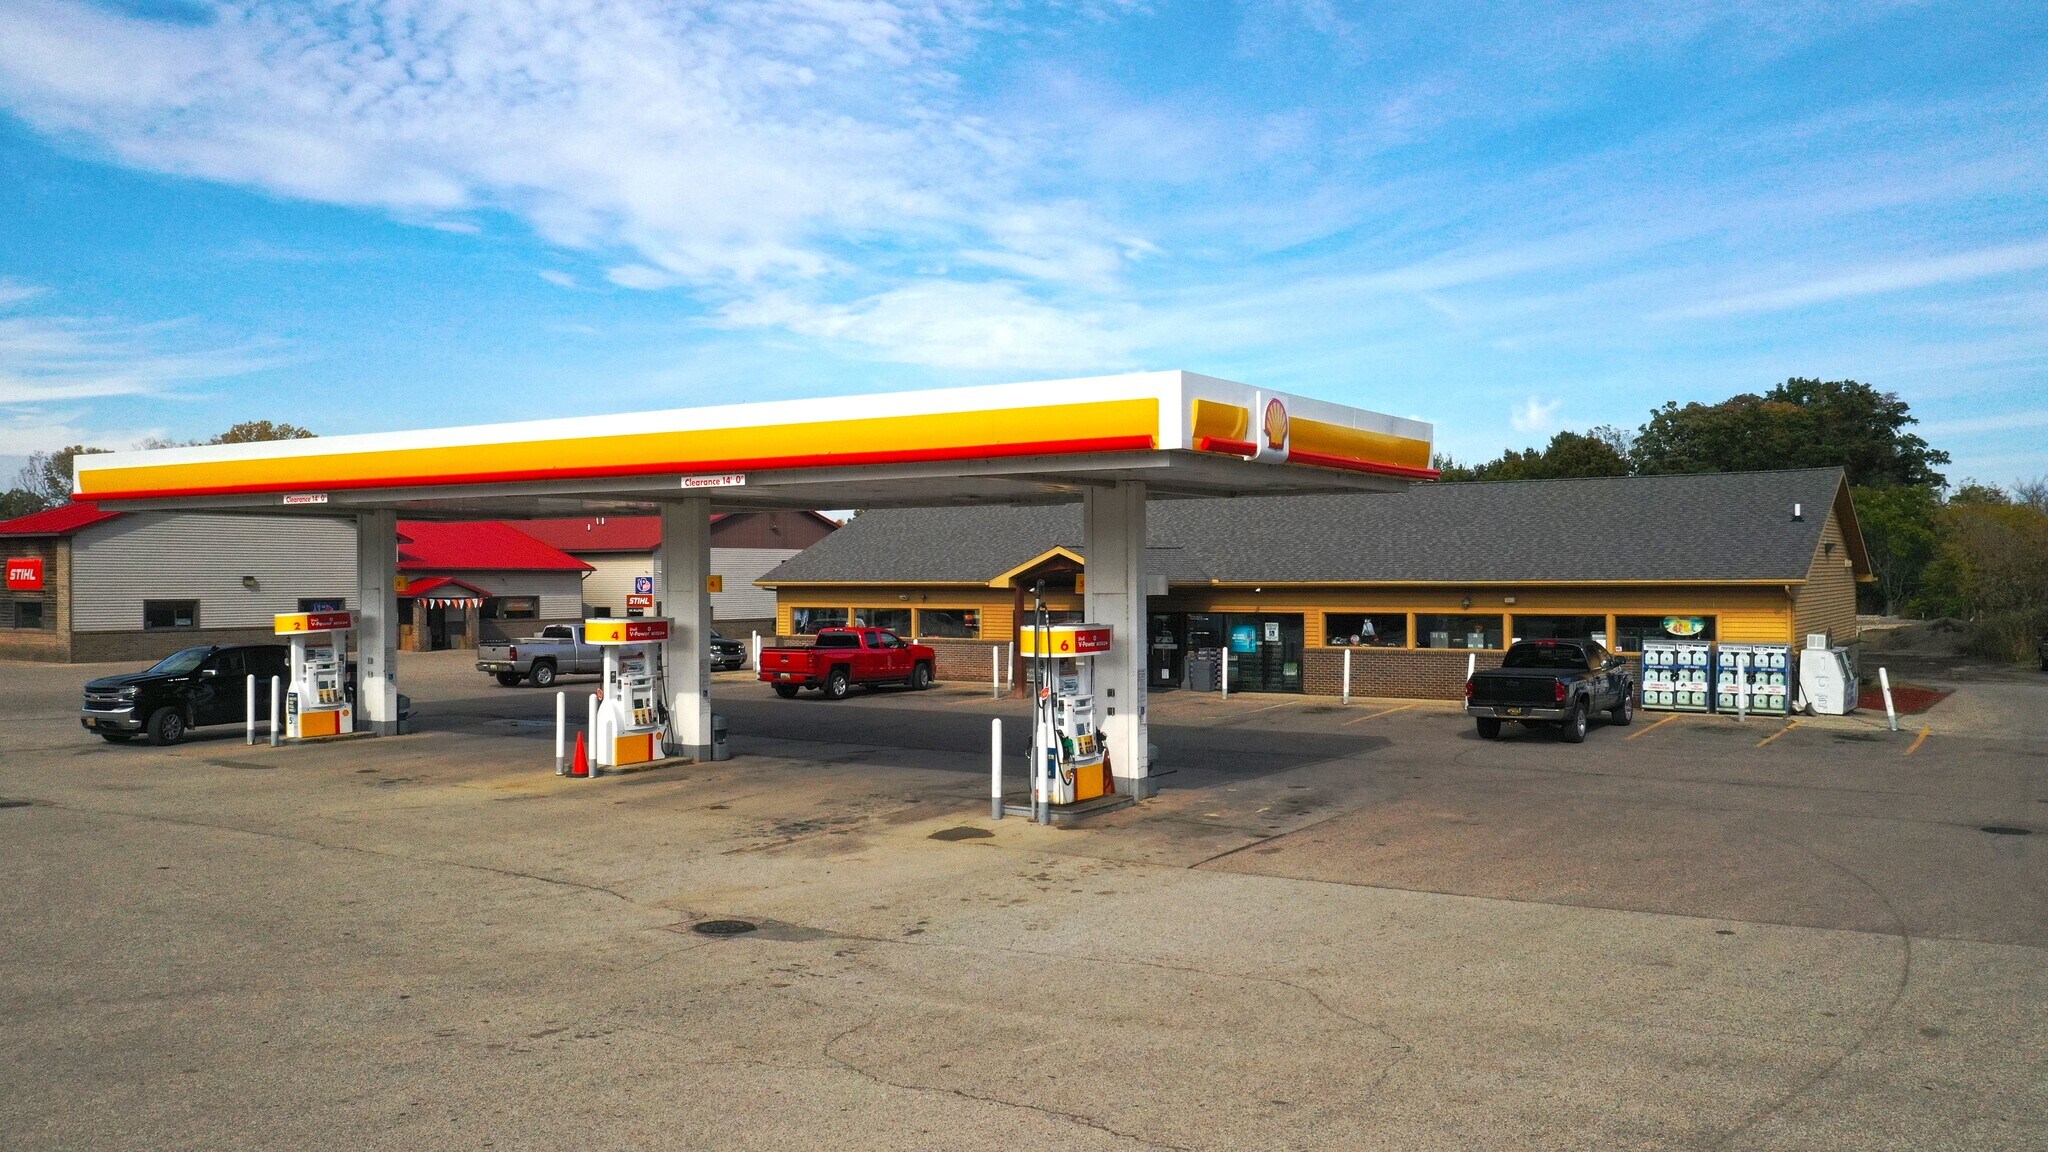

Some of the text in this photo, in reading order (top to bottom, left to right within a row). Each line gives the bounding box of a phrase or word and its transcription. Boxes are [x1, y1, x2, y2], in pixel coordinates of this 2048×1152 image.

[685, 477, 720, 486] Clearance
[286, 495, 311, 503] Clearance
[10, 568, 36, 580] STIHL
[628, 597, 650, 605] STIHL
[293, 622, 300, 630] 2
[611, 631, 619, 640] 4
[1060, 640, 1069, 651] 6
